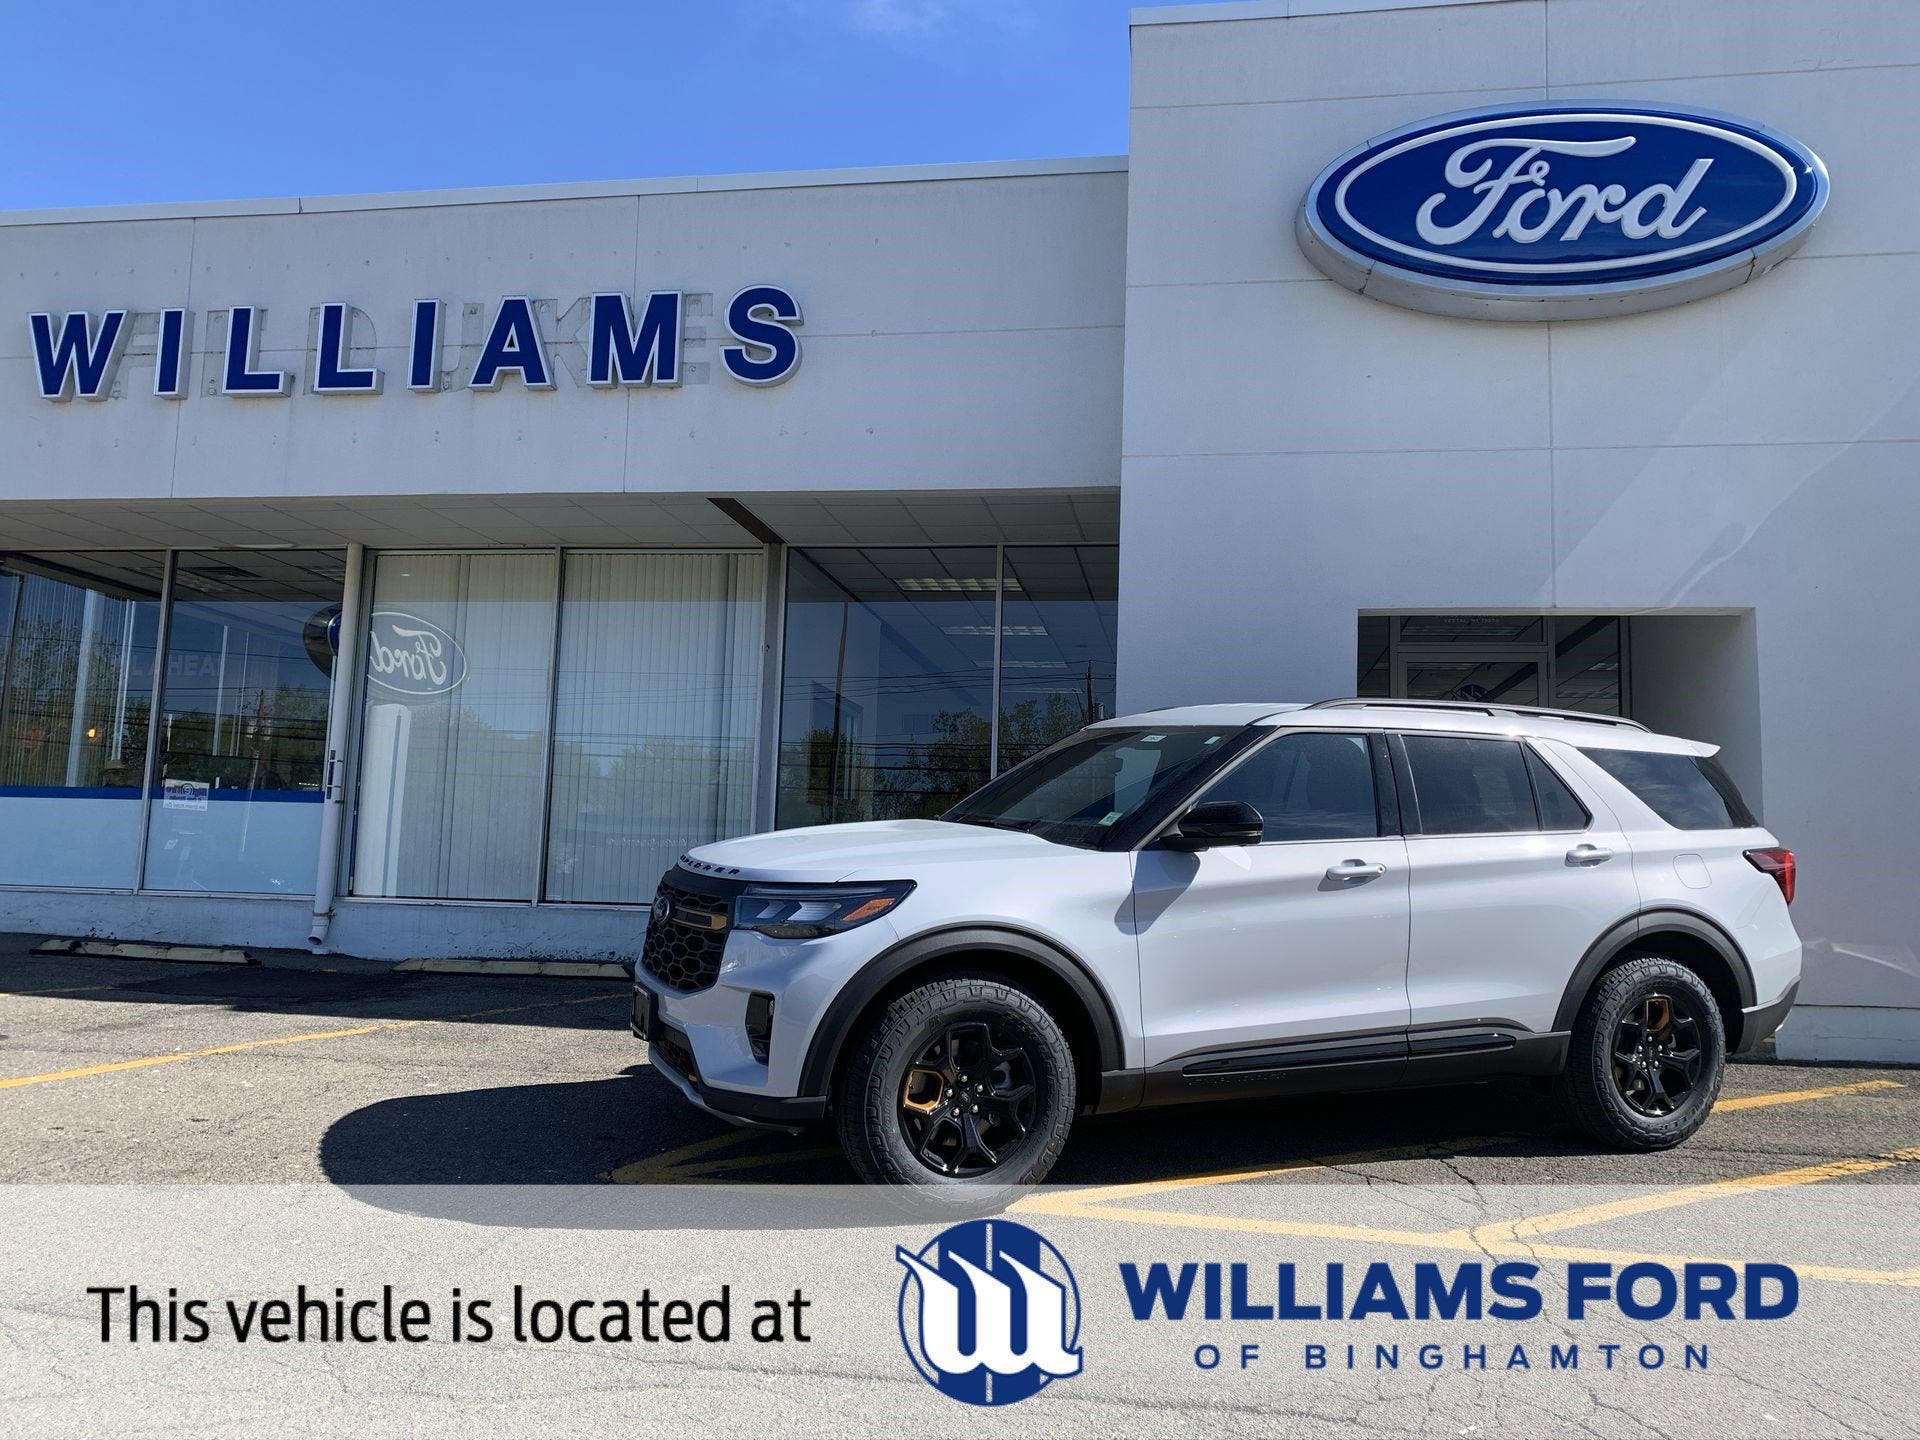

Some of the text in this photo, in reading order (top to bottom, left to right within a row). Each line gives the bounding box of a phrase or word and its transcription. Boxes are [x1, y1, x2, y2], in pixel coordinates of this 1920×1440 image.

[1416, 136, 1714, 246] Ford
[27, 284, 804, 403] WILLIAMS
[679, 853, 740, 875] XPLORER
